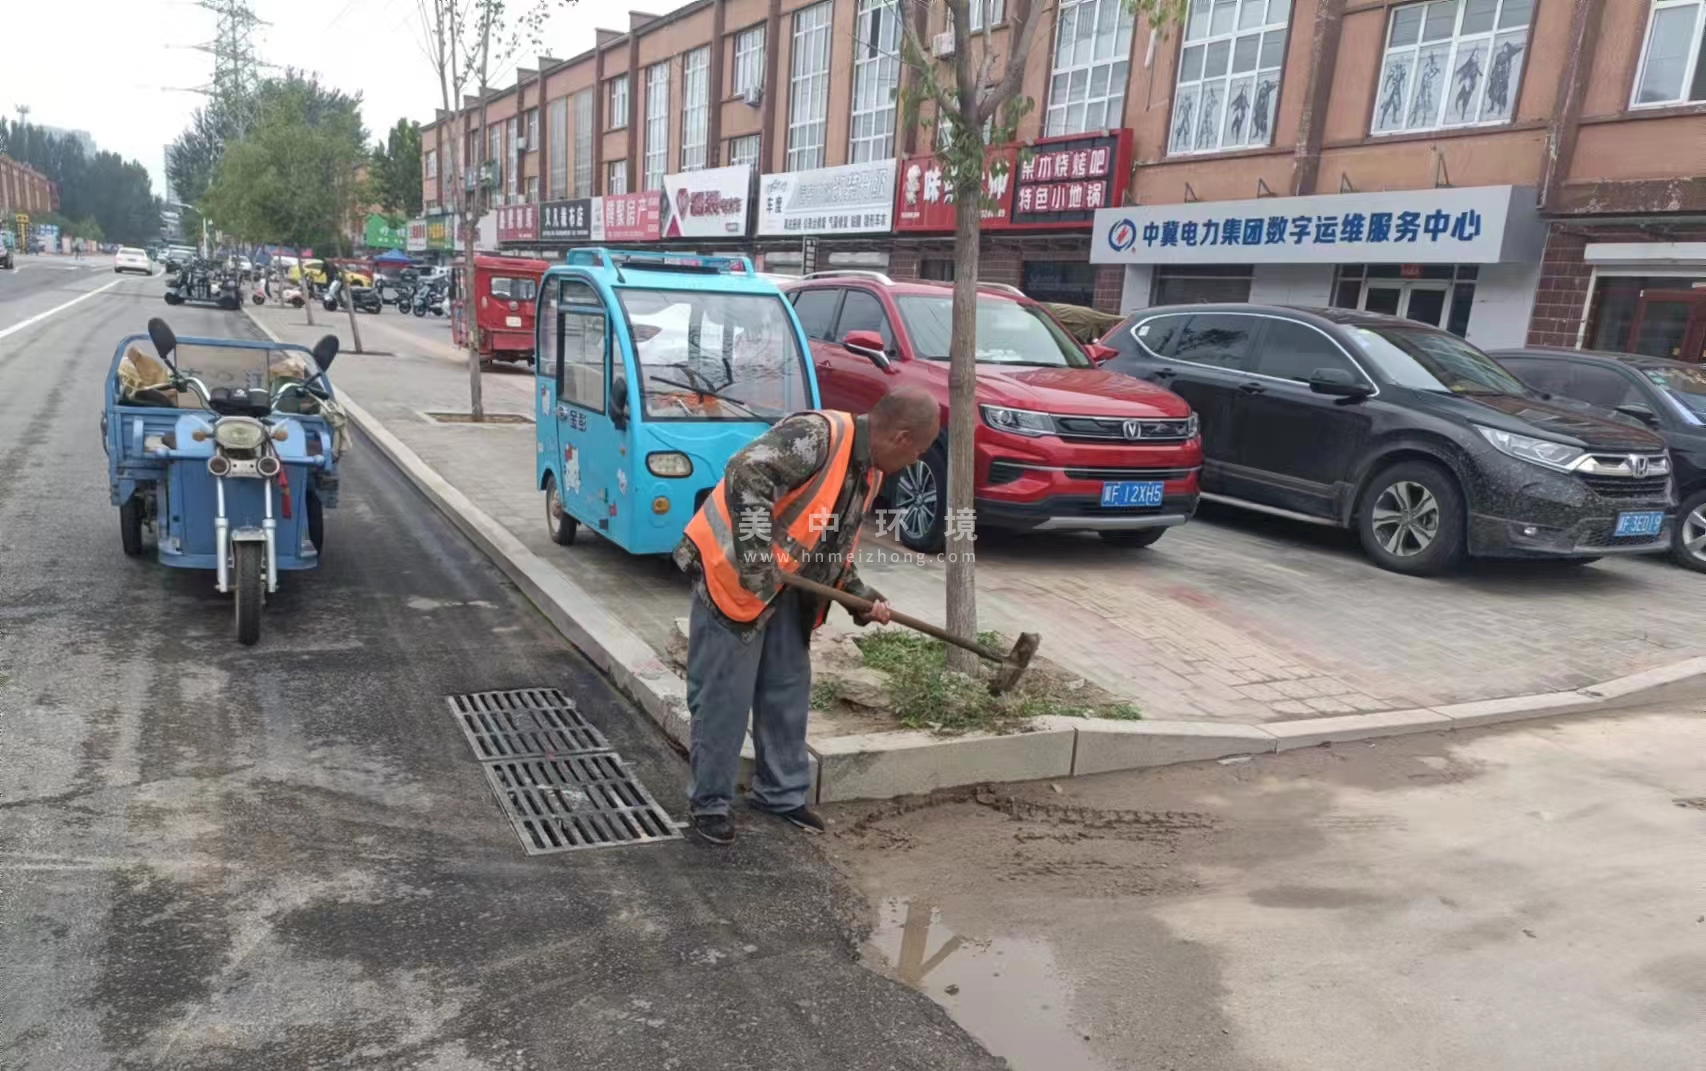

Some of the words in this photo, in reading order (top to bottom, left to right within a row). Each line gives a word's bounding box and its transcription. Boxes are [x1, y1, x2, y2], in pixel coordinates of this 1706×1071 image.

[1018, 183, 1102, 211] 特色小地锅
[1143, 208, 1481, 247] 中冀电力集团数字运维服务中心
